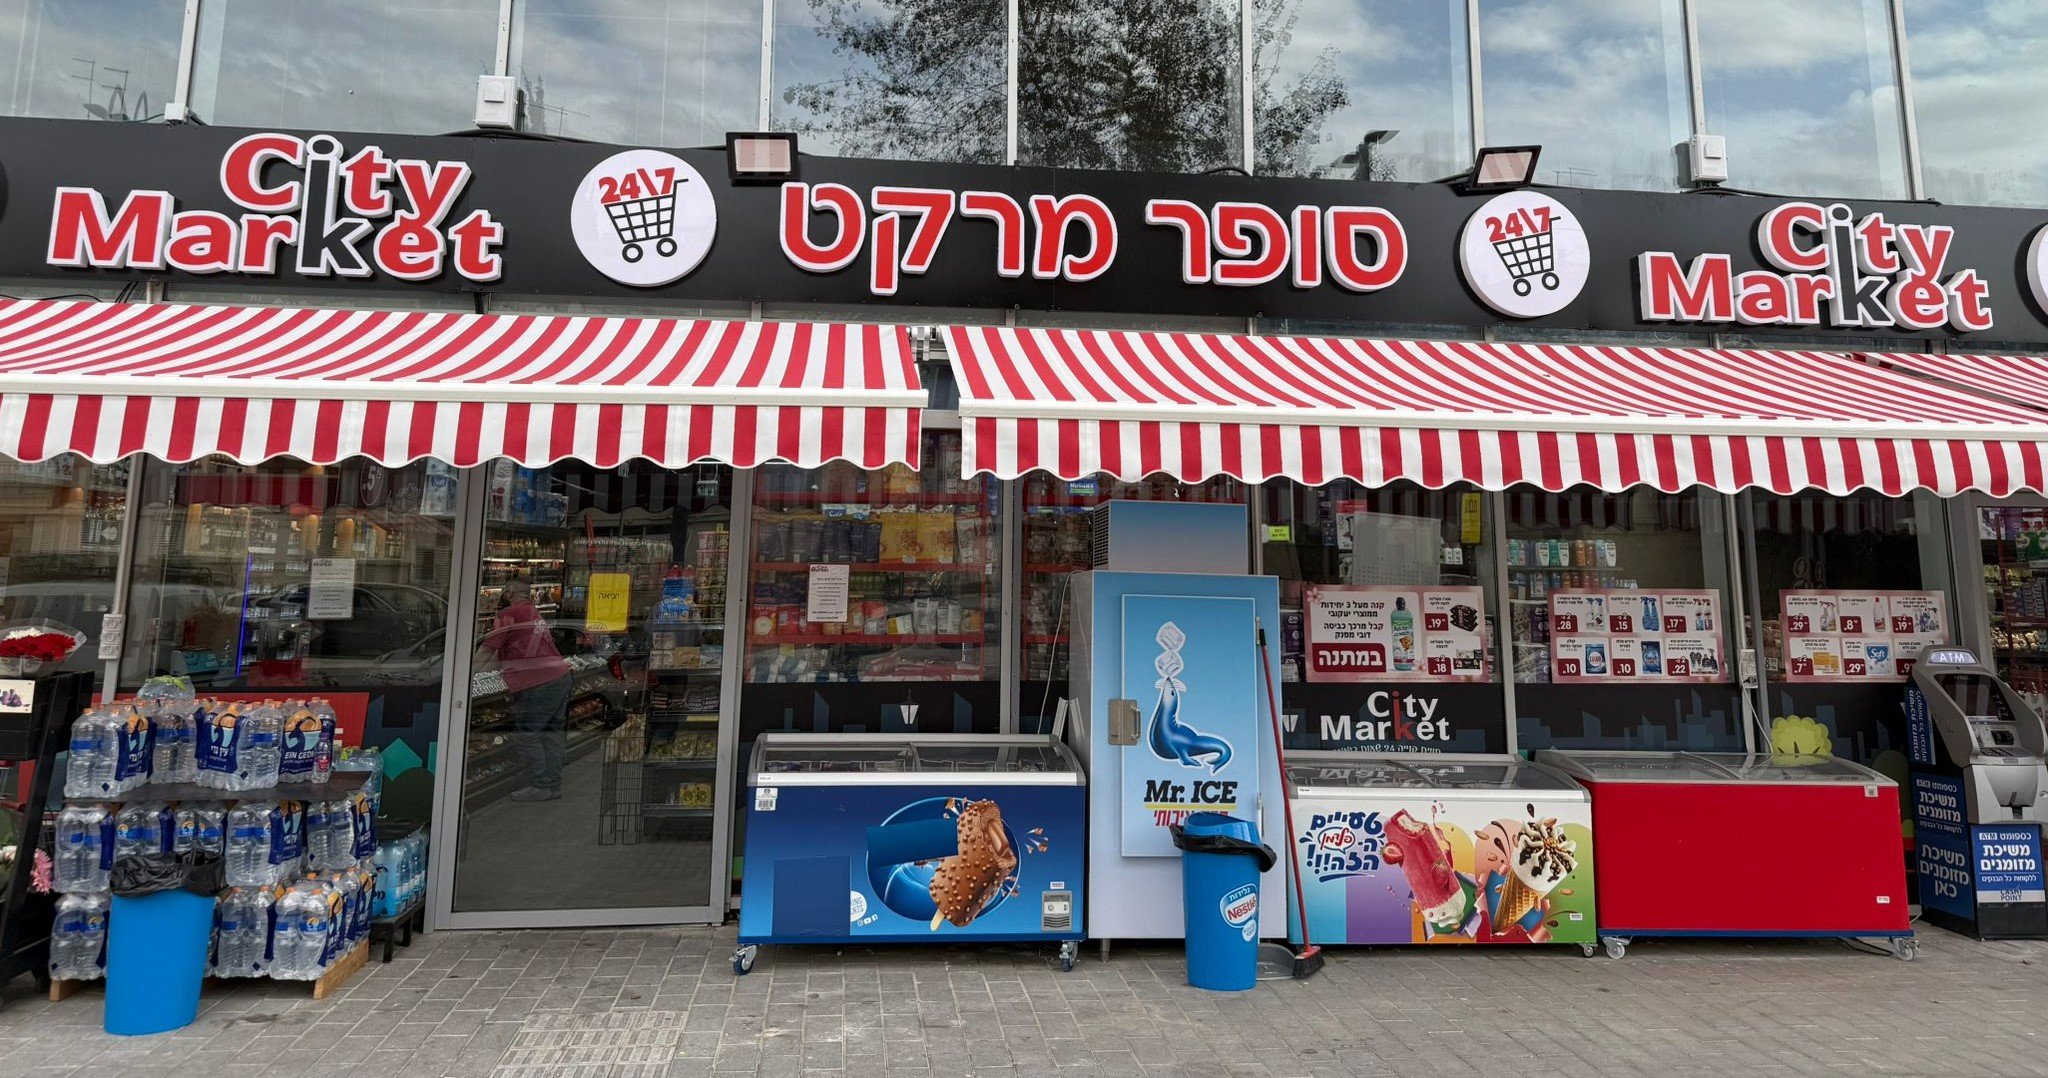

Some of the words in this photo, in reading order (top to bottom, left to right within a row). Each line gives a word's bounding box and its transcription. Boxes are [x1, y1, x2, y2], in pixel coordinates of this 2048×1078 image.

[220, 132, 471, 224] City
[598, 166, 676, 203] 24\7
[1485, 205, 1552, 240] 24\7
[47, 186, 504, 282] Market
[780, 182, 1118, 296] מרקט
[1145, 198, 1408, 293] סופר
[1758, 201, 1955, 283] City
[1639, 250, 1994, 332] Market
[598, 592, 620, 600] יציאה
[1320, 601, 1344, 609] יחידות
[1345, 601, 1351, 609] 3
[1353, 600, 1369, 609] מעל
[1370, 601, 1385, 610] קנה
[1353, 610, 1378, 618] ממוצרי
[1324, 622, 1346, 630] כביסה
[1348, 622, 1367, 631] מרכך
[1368, 621, 1384, 631] קבל
[1431, 618, 1441, 627] 19
[1560, 621, 1572, 630] 28
[1618, 621, 1628, 630] 15
[1670, 618, 1679, 628] 17
[1793, 621, 1804, 631] 29
[1846, 619, 1854, 631] 8
[1898, 621, 1908, 631] 19
[1335, 631, 1355, 640] מפנק
[1357, 631, 1371, 639] דובי
[1318, 650, 1383, 666] במתנה
[1939, 651, 1965, 663] ATM
[1436, 663, 1447, 673] 18
[1565, 663, 1577, 673] 10
[1620, 663, 1631, 673] 10
[1674, 664, 1686, 674] 22
[1849, 663, 1861, 673] 29
[1366, 690, 1439, 721] City
[1320, 713, 1450, 741] Market
[284, 751, 298, 760] EIN
[1144, 779, 1185, 803] Mr.
[1191, 780, 1238, 804] ICE
[1919, 791, 1957, 808] משיכת
[1918, 804, 1962, 823] מזומנים
[1320, 827, 1353, 850] פלדמן
[1979, 832, 1998, 841] ATM
[1999, 832, 2032, 841] כספומט
[1921, 844, 1966, 867] משיכת
[1982, 844, 2031, 857] משיכת
[1980, 858, 2036, 871] מזומנים
[1919, 860, 1970, 886] מזומנים
[2004, 874, 2012, 882] כל
[1981, 875, 2004, 883] הבנקים
[2013, 874, 2037, 883] ללקוחות
[1934, 879, 1958, 898] כאן
[2000, 894, 2022, 902] POINT
